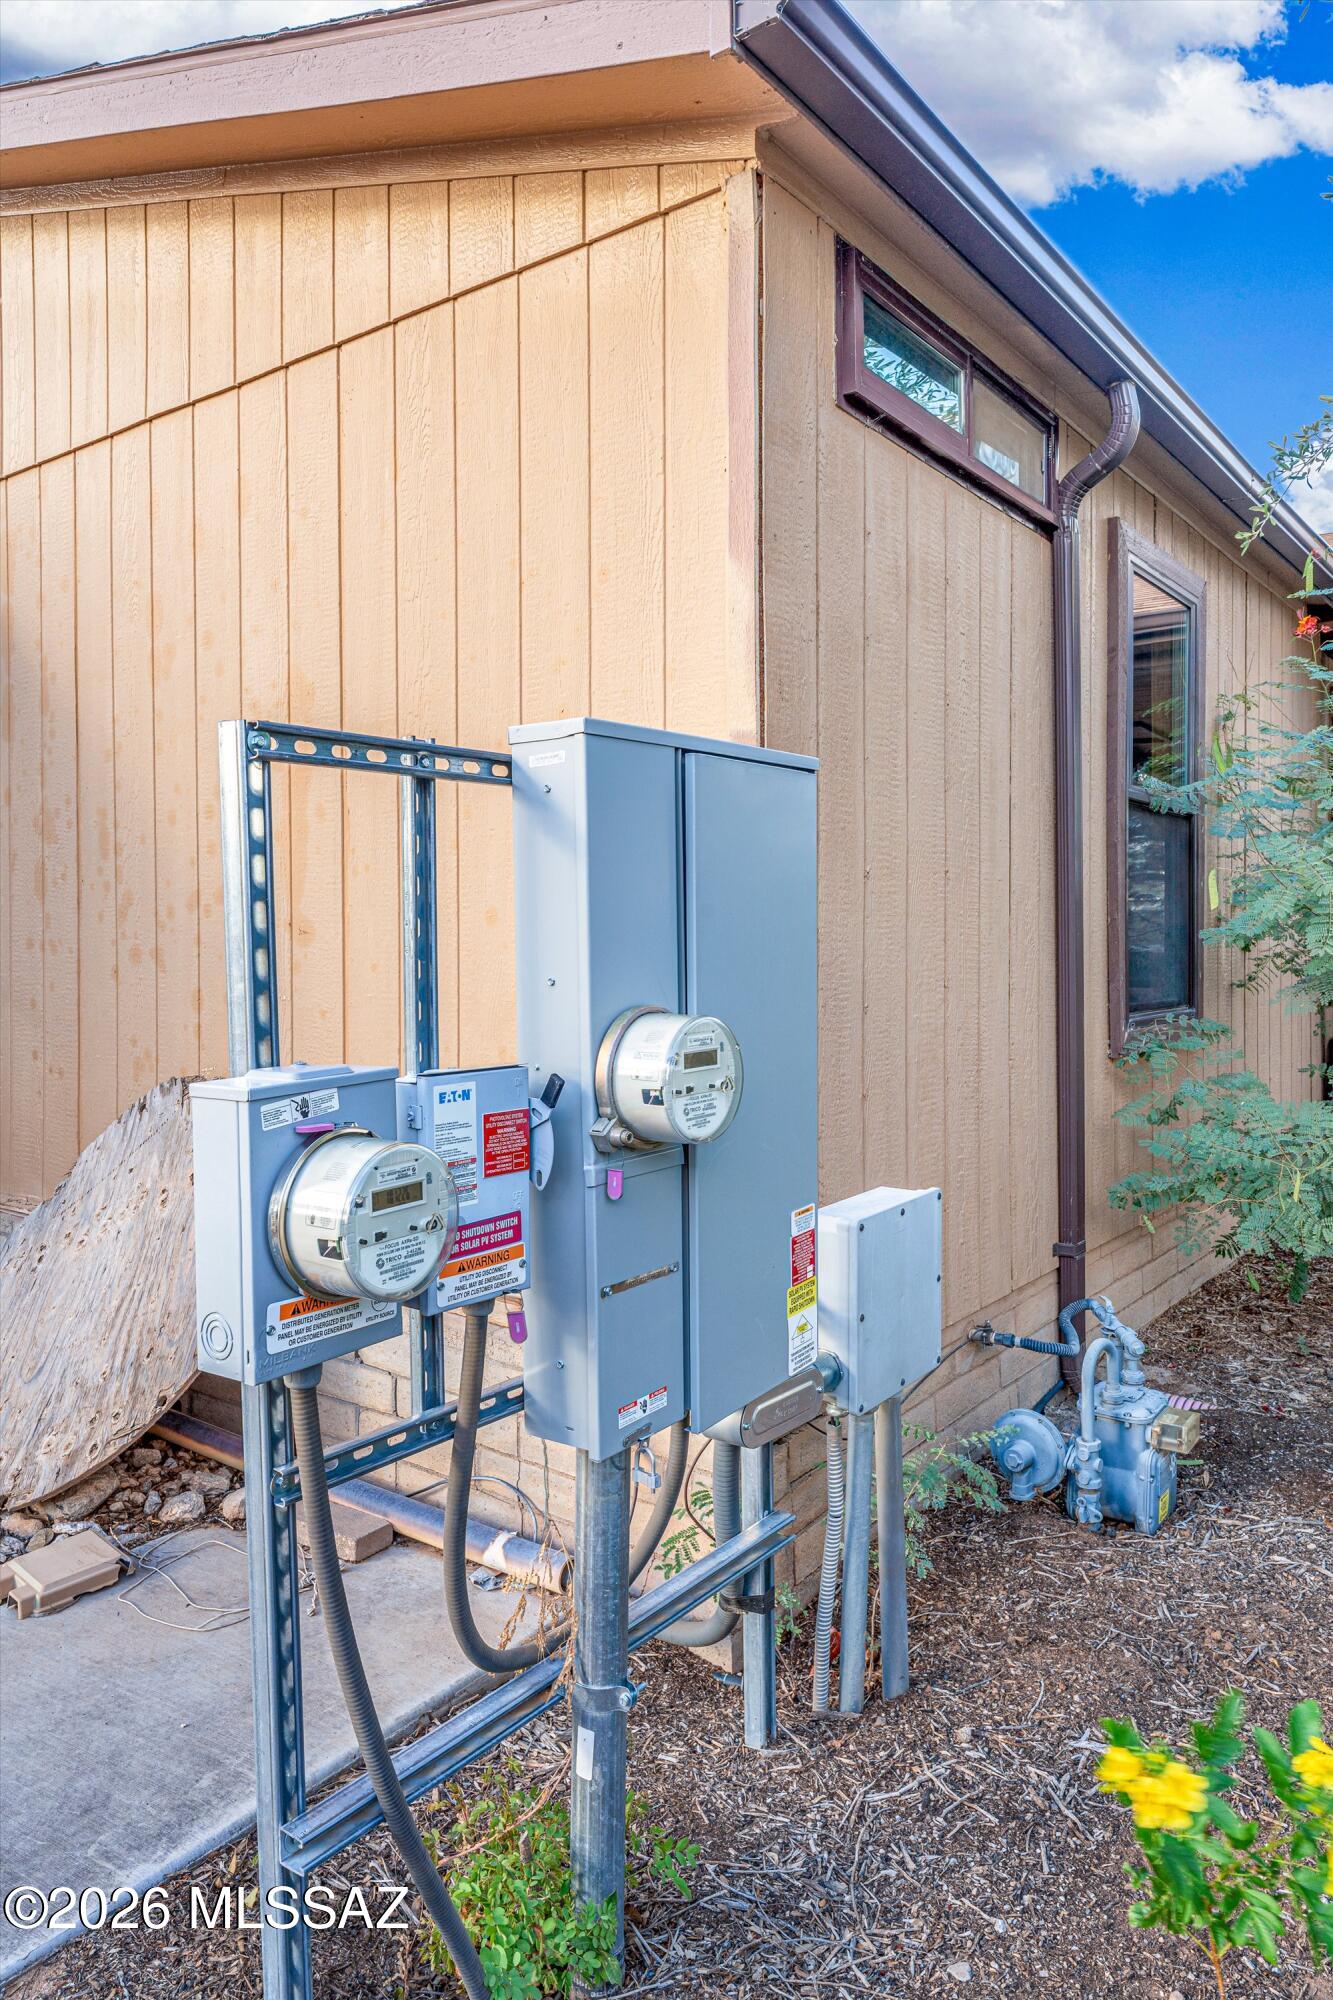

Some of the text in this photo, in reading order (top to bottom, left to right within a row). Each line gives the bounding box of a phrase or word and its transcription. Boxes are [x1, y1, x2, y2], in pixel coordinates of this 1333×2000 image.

[439, 1089, 471, 1104] EATON
[462, 1223, 494, 1239] SHUTDOWN
[496, 1217, 518, 1229] SWITCH
[461, 1239, 479, 1251] SOLAR
[481, 1237, 489, 1245] PV
[490, 1230, 514, 1243] SYSTEM
[385, 1254, 402, 1263] TRICO
[466, 1250, 510, 1269] WARNING
[454, 1284, 468, 1292] PANEL
[484, 1272, 506, 1284] ENERGIZED
[460, 1274, 474, 1282] UTILITY
[482, 1264, 508, 1277] DISCONNECT
[448, 1292, 464, 1302] UTILITY
[471, 1284, 494, 1296] CUSTOMER
[494, 1277, 518, 1290] GENERATION
[282, 1316, 314, 1330] DISTRIBUTED
[314, 1307, 344, 1320] GENERATION
[344, 1302, 360, 1313] METER
[366, 1310, 394, 1322] UTILITY SOURCE
[278, 1312, 362, 1341] PANEL MAY BE ENERGIZED BY UTILITY
[296, 1332, 324, 1344] CUSTOMER
[324, 1322, 354, 1336] GENERATION
